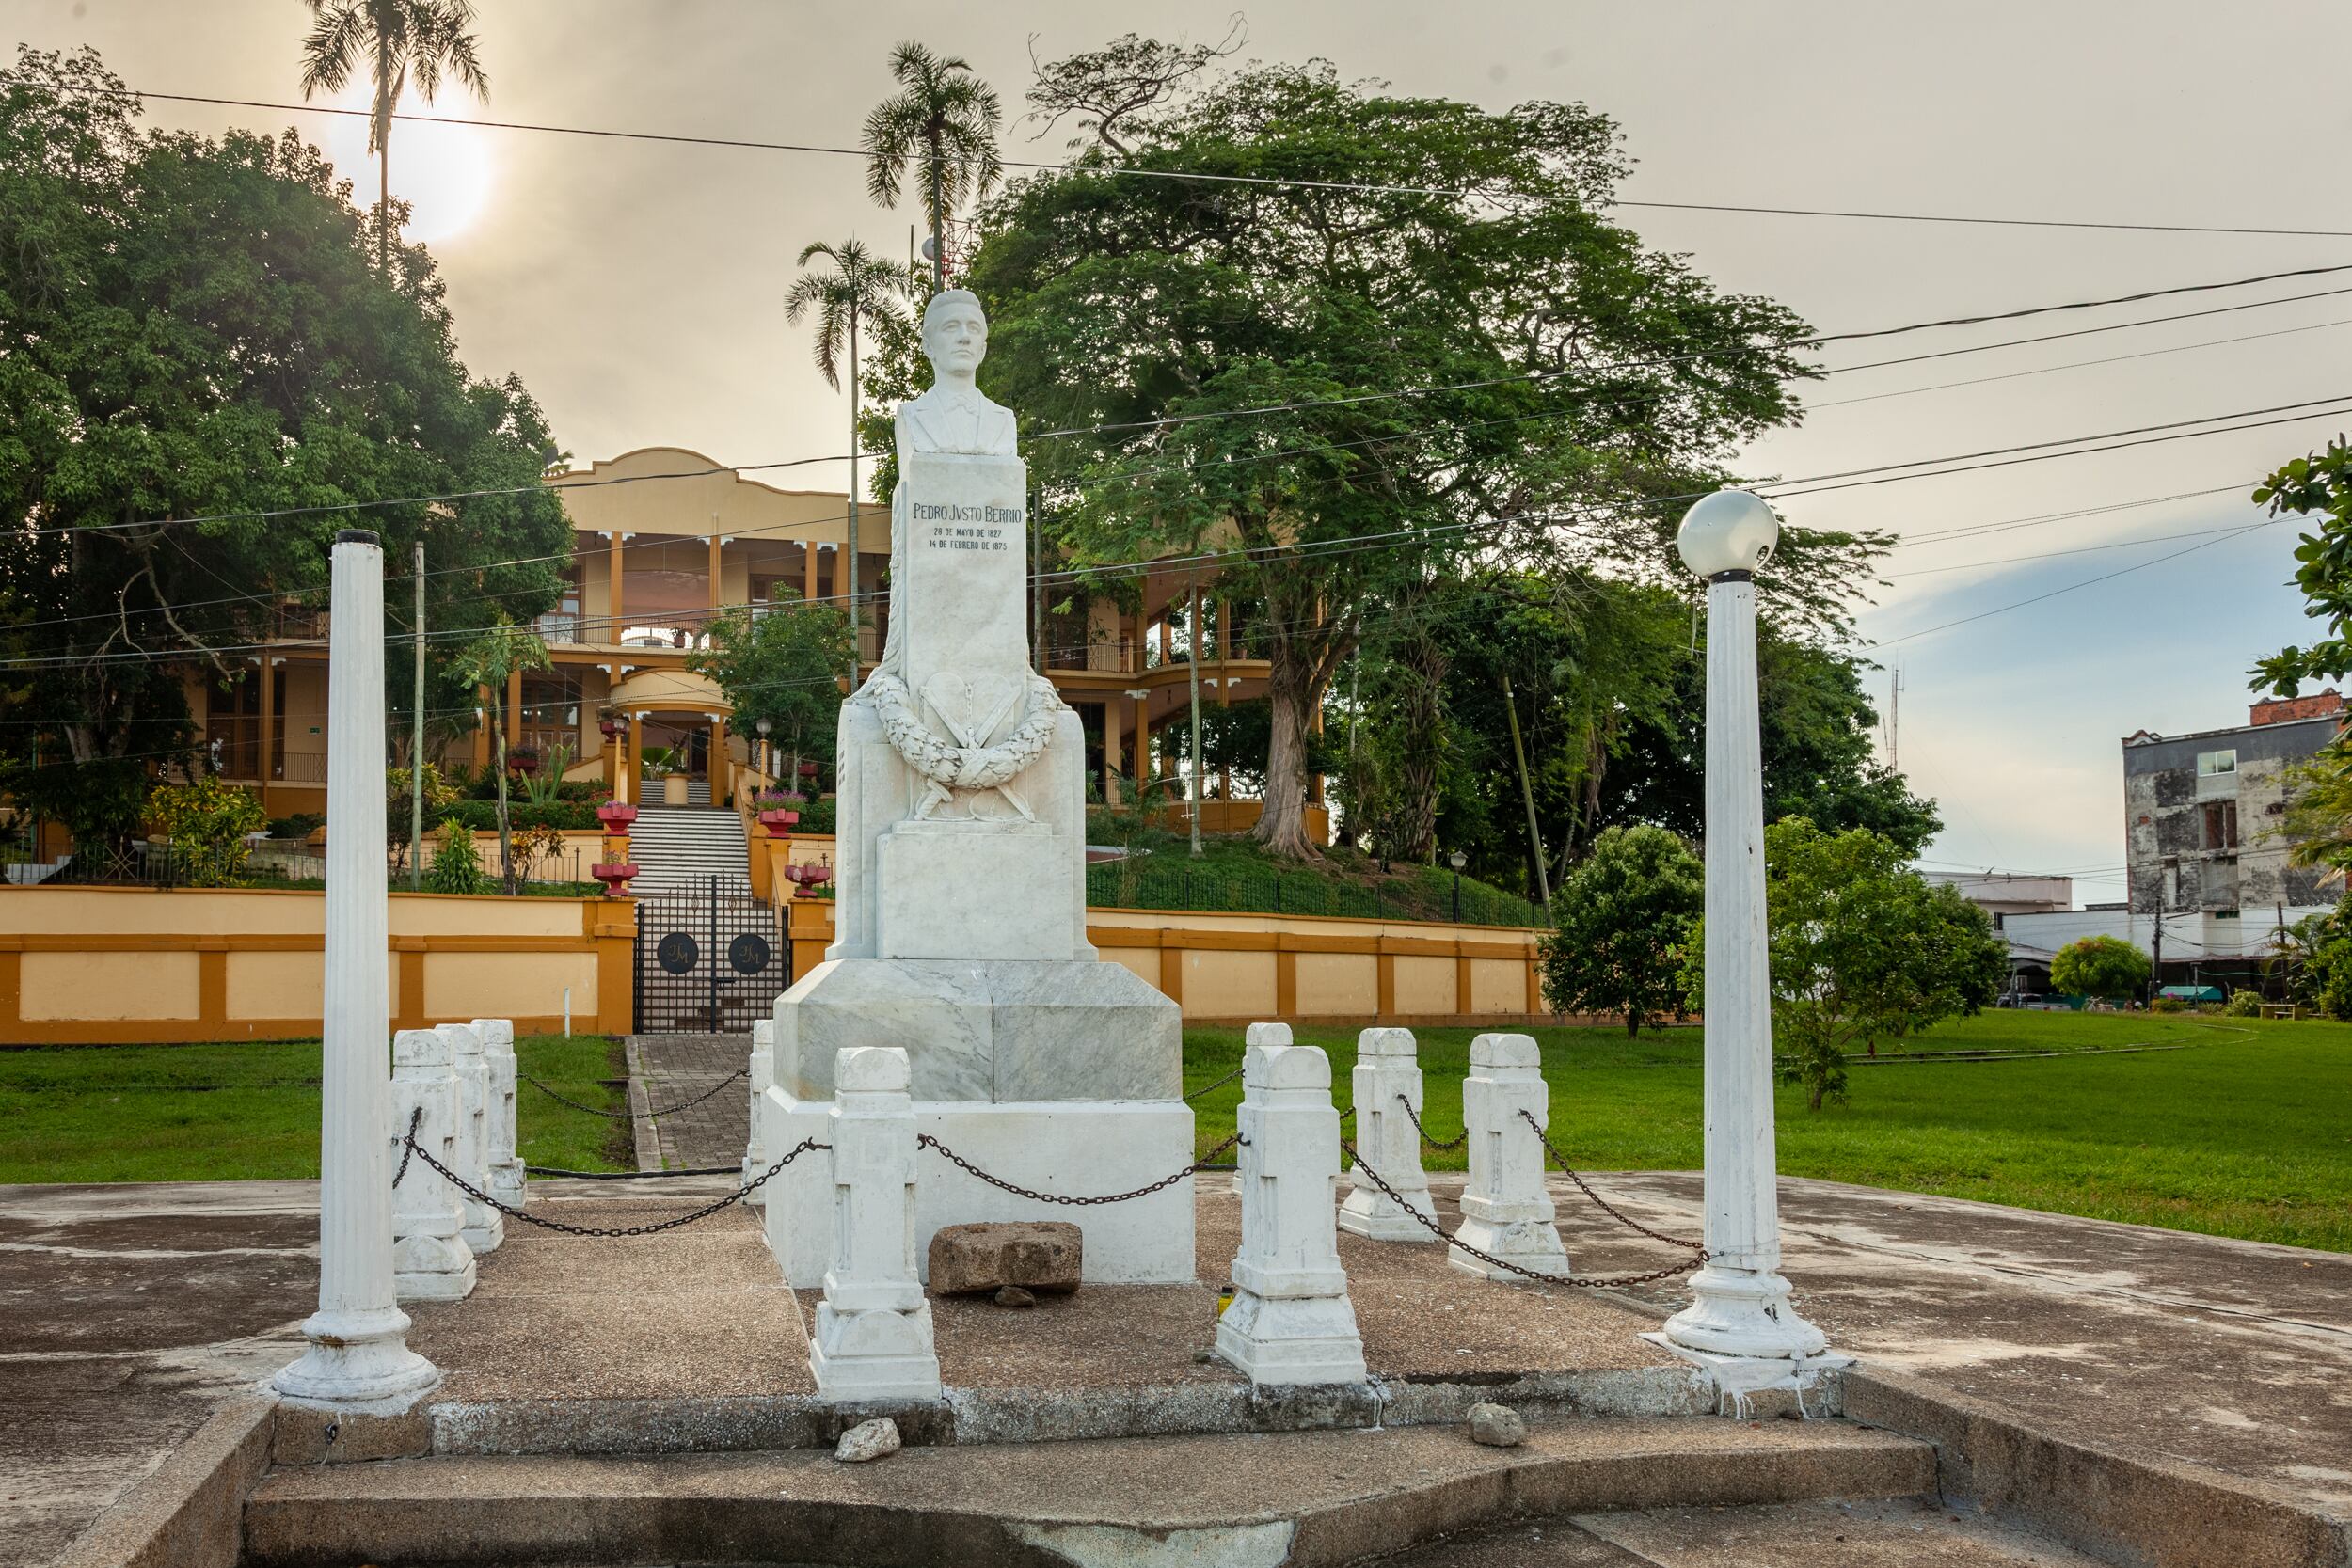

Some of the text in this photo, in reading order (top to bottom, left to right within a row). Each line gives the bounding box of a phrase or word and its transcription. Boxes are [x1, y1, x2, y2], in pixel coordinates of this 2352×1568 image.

[914, 503, 947, 519] PEDRO
[985, 506, 1022, 523] BERRIO
[946, 528, 953, 536] DE
[956, 529, 974, 537] MAYO
[977, 529, 985, 537] DE
[987, 529, 1002, 538] 1827
[939, 540, 946, 548] DE
[950, 541, 978, 549] FEBRERO
[981, 541, 990, 550] DE
[993, 542, 1008, 550] 1875
